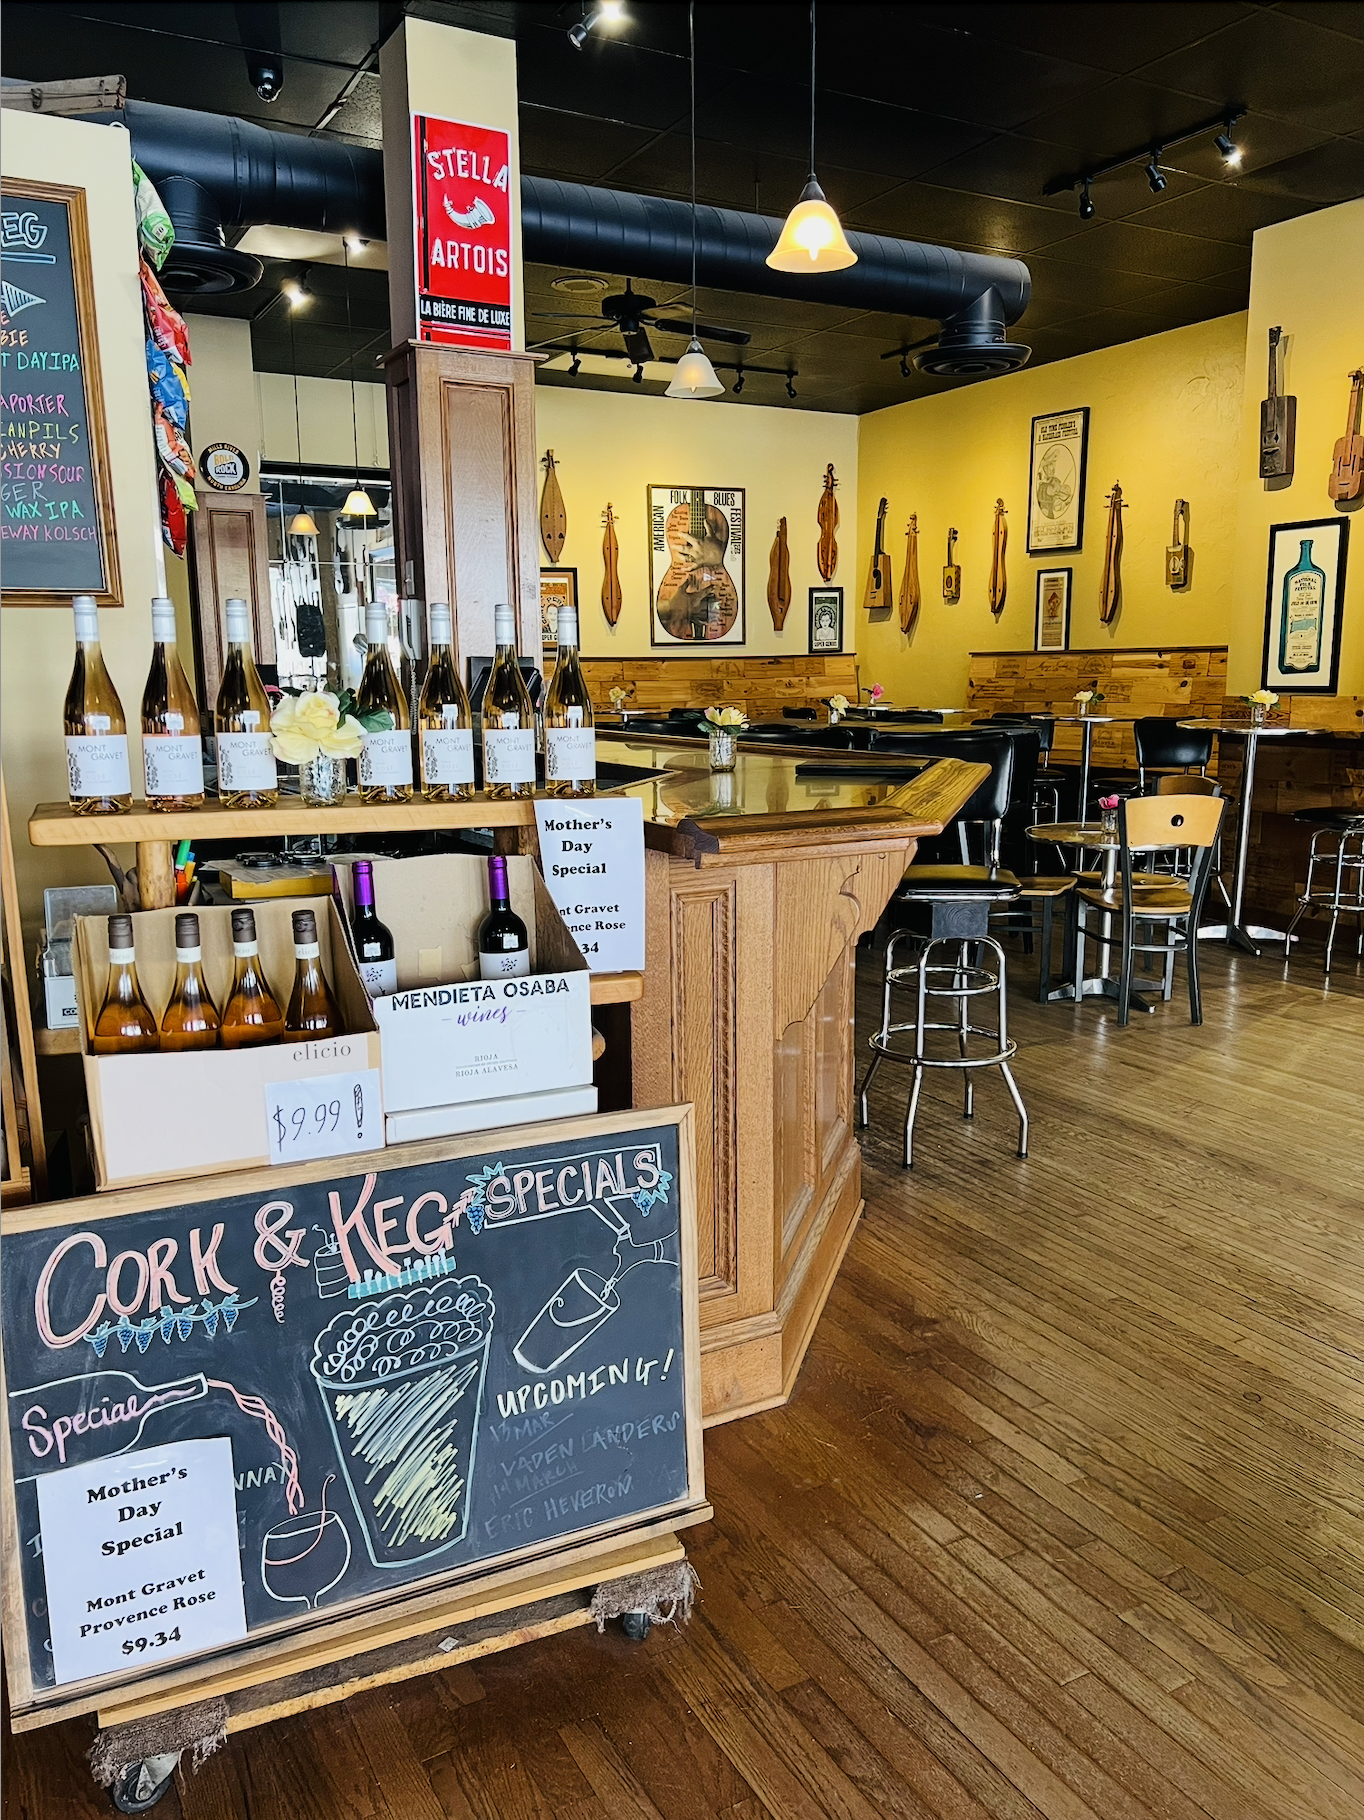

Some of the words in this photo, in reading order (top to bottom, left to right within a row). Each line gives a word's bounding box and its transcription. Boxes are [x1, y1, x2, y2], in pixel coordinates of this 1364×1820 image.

[428, 147, 508, 192] STELLA
[431, 237, 508, 277] ARTOIS
[420, 299, 432, 316] LA
[433, 300, 457, 320] BIÈRE
[458, 305, 476, 322] FINE
[478, 308, 489, 324] DE
[490, 309, 510, 326] LUXE
[214, 454, 234, 466] BOLD
[214, 461, 238, 475] ROCK
[49, 463, 85, 484] SOUR
[670, 489, 688, 504] FOLK
[713, 491, 736, 507] BLUES
[5, 500, 42, 520] WAX
[45, 499, 84, 520] IPA
[44, 524, 98, 544] KOLSCH
[652, 504, 665, 552] AMERICAN
[730, 507, 742, 544] FESTIVAL
[78, 744, 106, 753] MONT
[156, 744, 183, 752] MONT
[370, 738, 395, 746] MONT
[381, 745, 408, 753] GRAVET
[447, 744, 471, 752] GRAVET
[507, 743, 532, 752] GRAVET
[567, 742, 592, 750] GRAVET
[91, 752, 123, 761] GRAVET
[168, 751, 198, 761] GRAVET
[544, 818, 612, 832] Mother's
[562, 840, 593, 854] Day
[552, 863, 607, 878] Special
[559, 904, 571, 916] nt
[574, 904, 620, 915] Gravet
[595, 920, 626, 931] Rose
[391, 984, 496, 1012] MENDIETA
[503, 977, 570, 998] OSABA
[457, 1005, 512, 1027] wines
[293, 1042, 352, 1062] elicio
[474, 1053, 499, 1063] RIOJA
[455, 1068, 479, 1078] RIOJA
[482, 1063, 519, 1075] ALAVESA
[272, 1100, 341, 1152] $9.99
[35, 1222, 239, 1349] CORK
[253, 1200, 311, 1272] &
[328, 1173, 454, 1283] KEG
[484, 1151, 660, 1220] SPECIALS
[496, 1347, 674, 1419] UPCOMING!
[500, 1437, 574, 1477] VADEN
[580, 1410, 680, 1453] LANDERS
[86, 1467, 188, 1503] Mother's
[117, 1500, 163, 1523] Day
[484, 1506, 534, 1541] ERIC
[101, 1521, 183, 1556] Special
[86, 1589, 136, 1613] Mont
[141, 1568, 206, 1597] Gravet
[79, 1602, 168, 1638] Provence
[172, 1589, 217, 1612] Rose
[121, 1626, 182, 1656] $9.34
